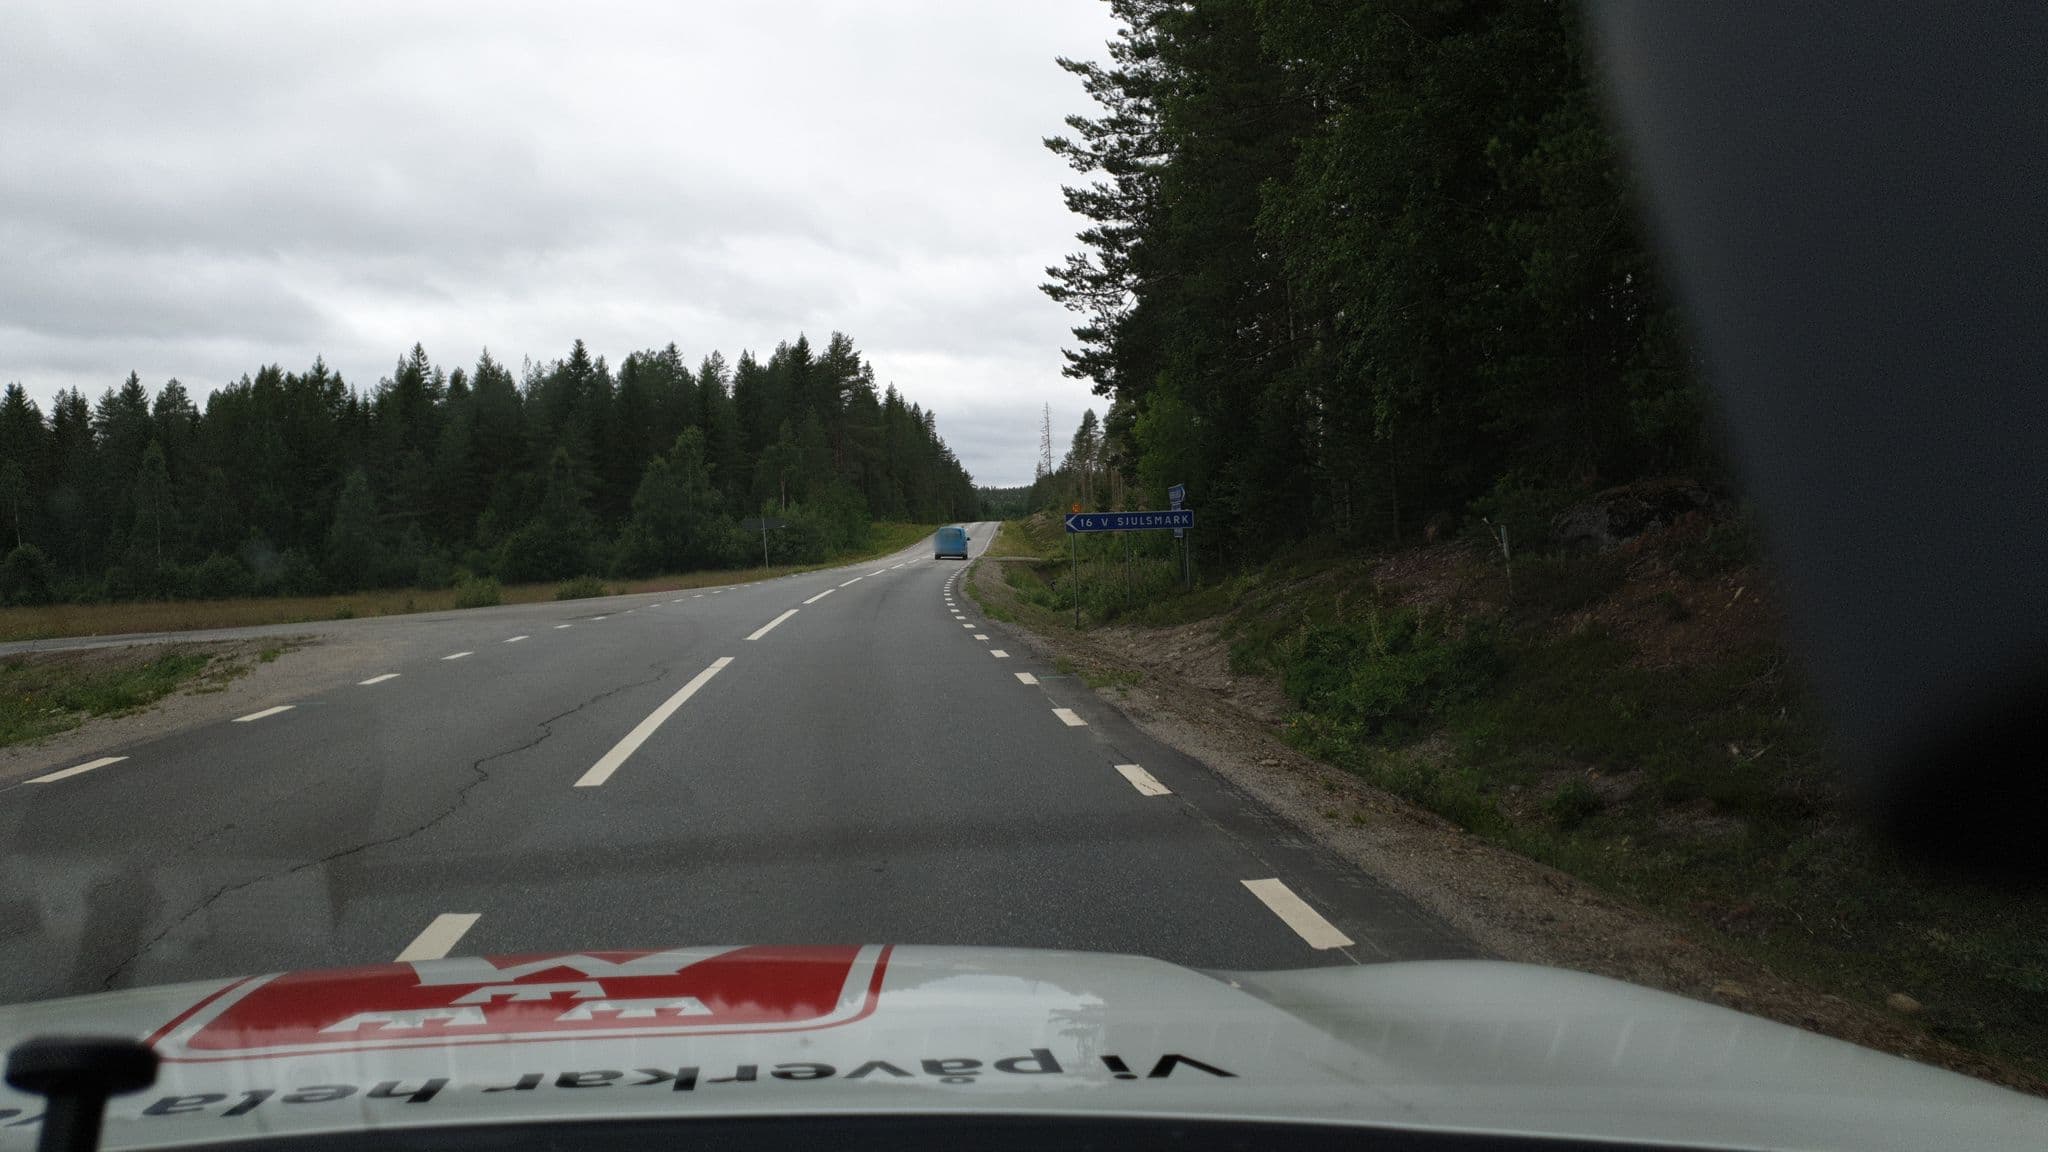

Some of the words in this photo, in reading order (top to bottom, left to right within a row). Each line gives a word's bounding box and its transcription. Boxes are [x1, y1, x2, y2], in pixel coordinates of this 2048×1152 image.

[1080, 518, 1093, 527] 16
[1100, 518, 1109, 527] V
[1117, 515, 1189, 526] SJULSMARK
[482, 1048, 1064, 1093] påverkar
[142, 1077, 449, 1117] hela
